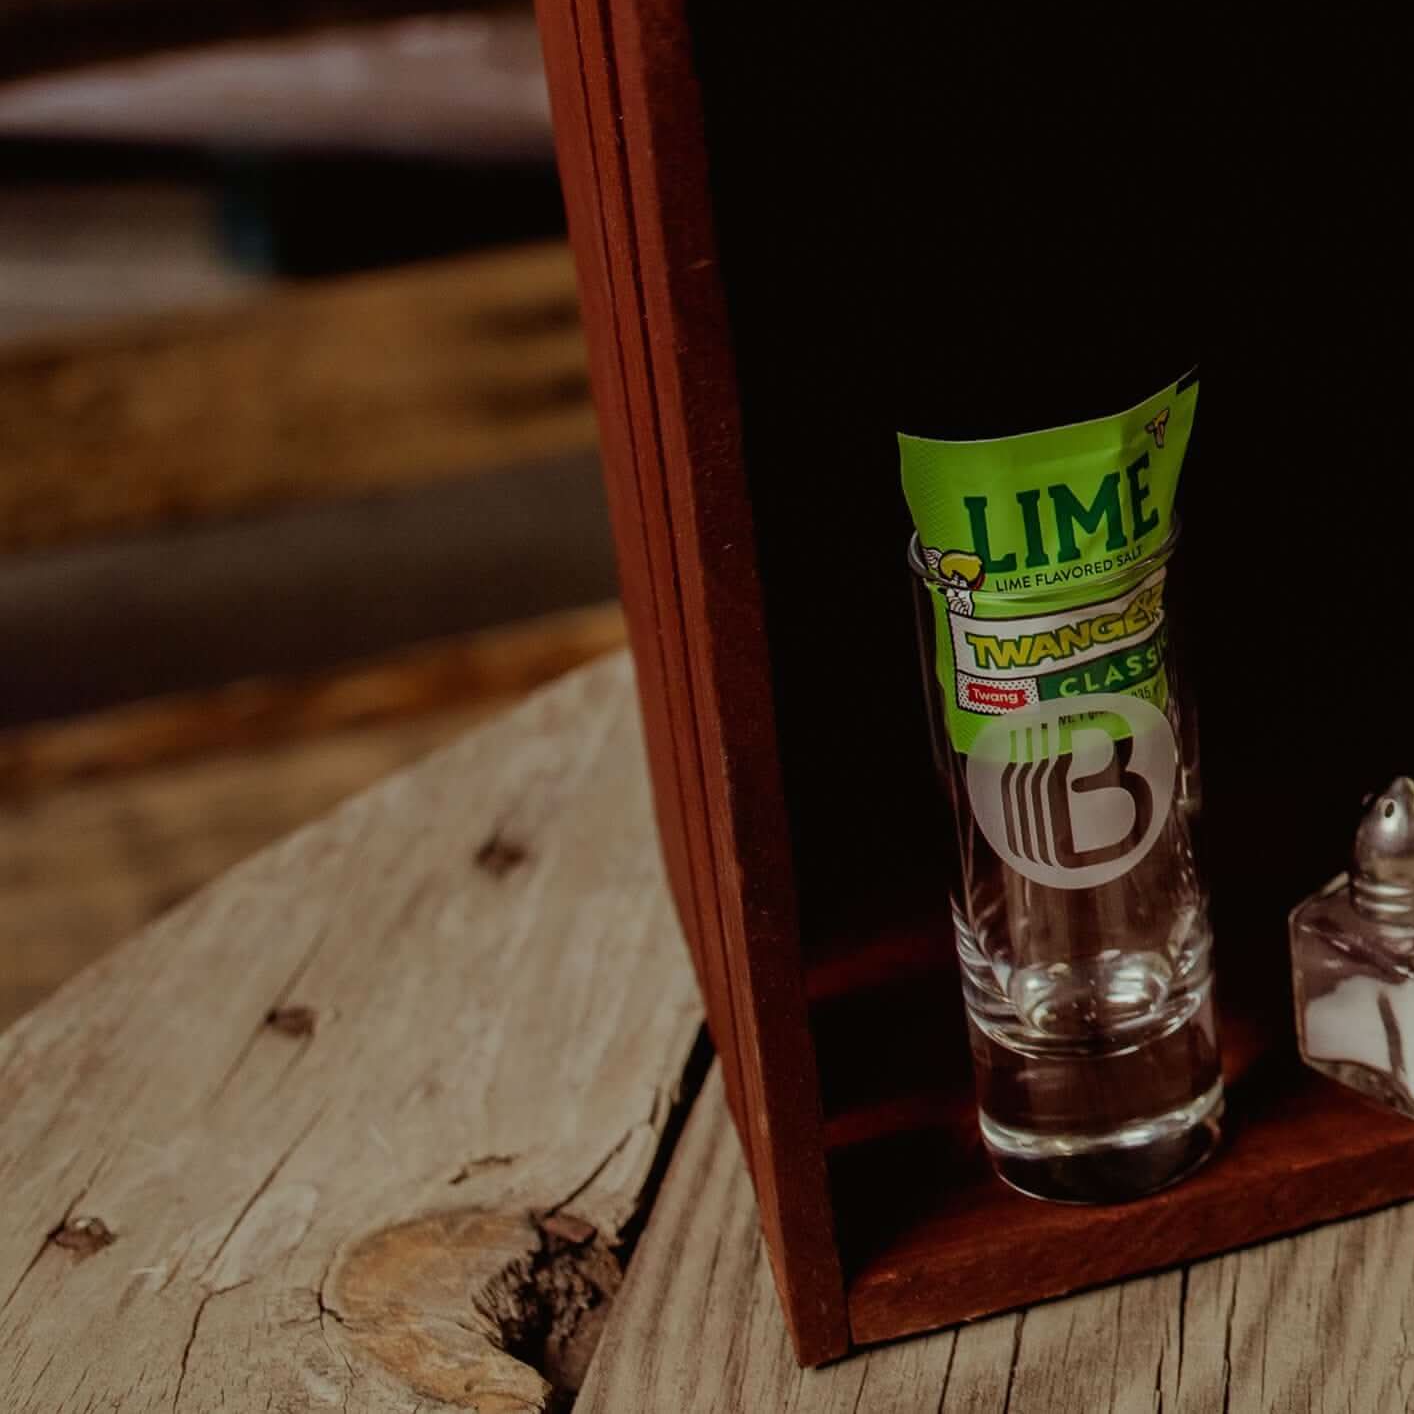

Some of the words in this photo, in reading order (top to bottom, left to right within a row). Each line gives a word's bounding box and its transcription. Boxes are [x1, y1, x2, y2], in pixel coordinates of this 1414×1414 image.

[963, 451, 1161, 575] LIME
[995, 575, 1032, 593] LIME
[1035, 559, 1113, 588] FLAVORED
[1116, 546, 1143, 568] SALT
[974, 683, 1018, 704] Twang
